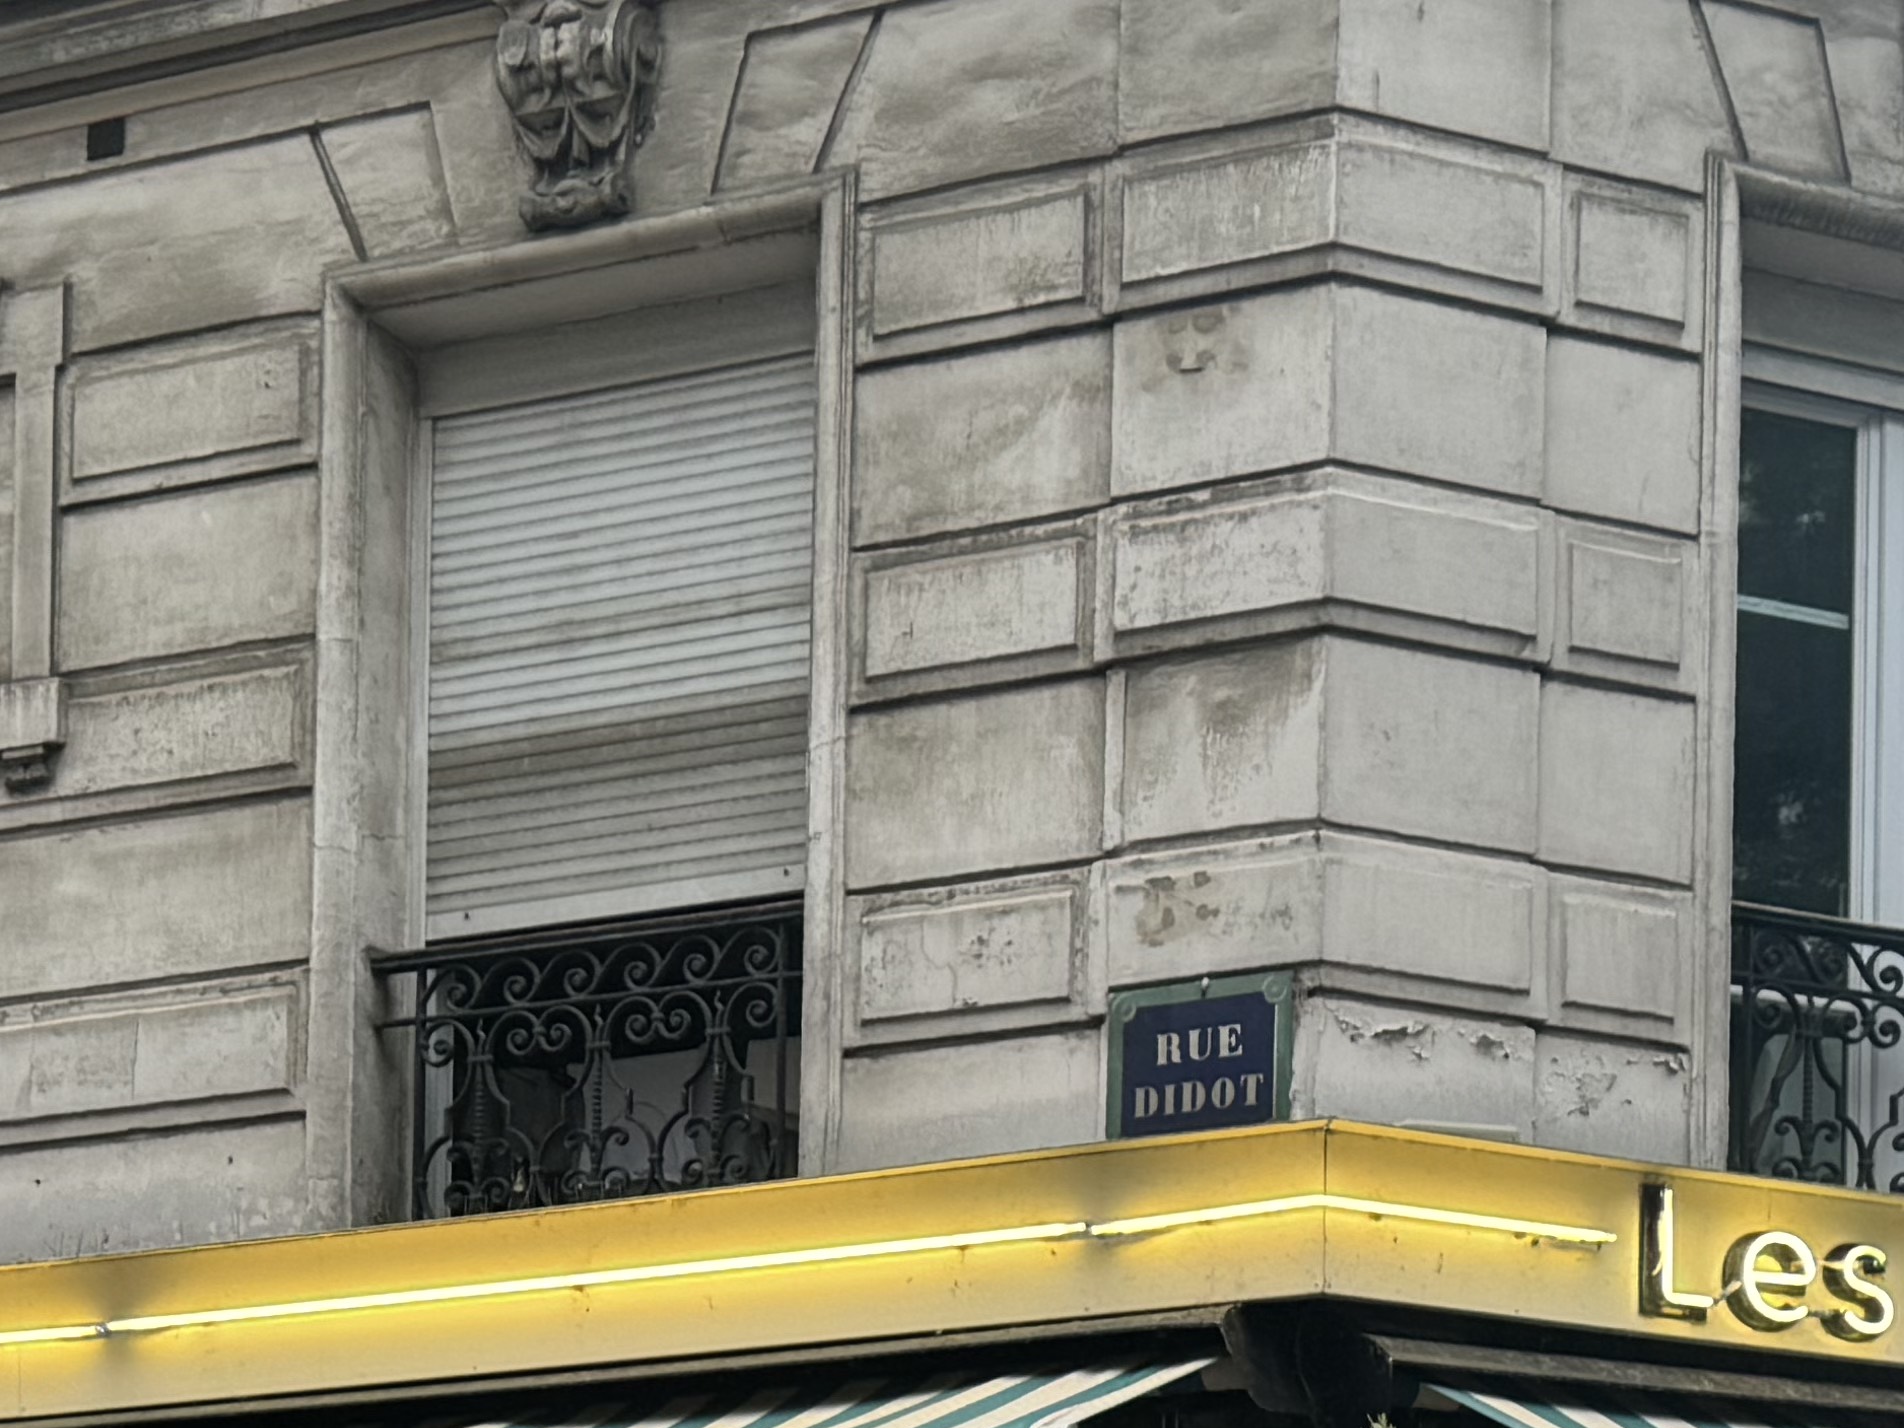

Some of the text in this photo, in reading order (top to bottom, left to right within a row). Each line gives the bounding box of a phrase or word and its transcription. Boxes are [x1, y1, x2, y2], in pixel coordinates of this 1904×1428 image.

[1157, 1024, 1243, 1066] RUE
[1134, 1073, 1264, 1118] DIDOT
[1639, 1184, 1895, 1341] Les
